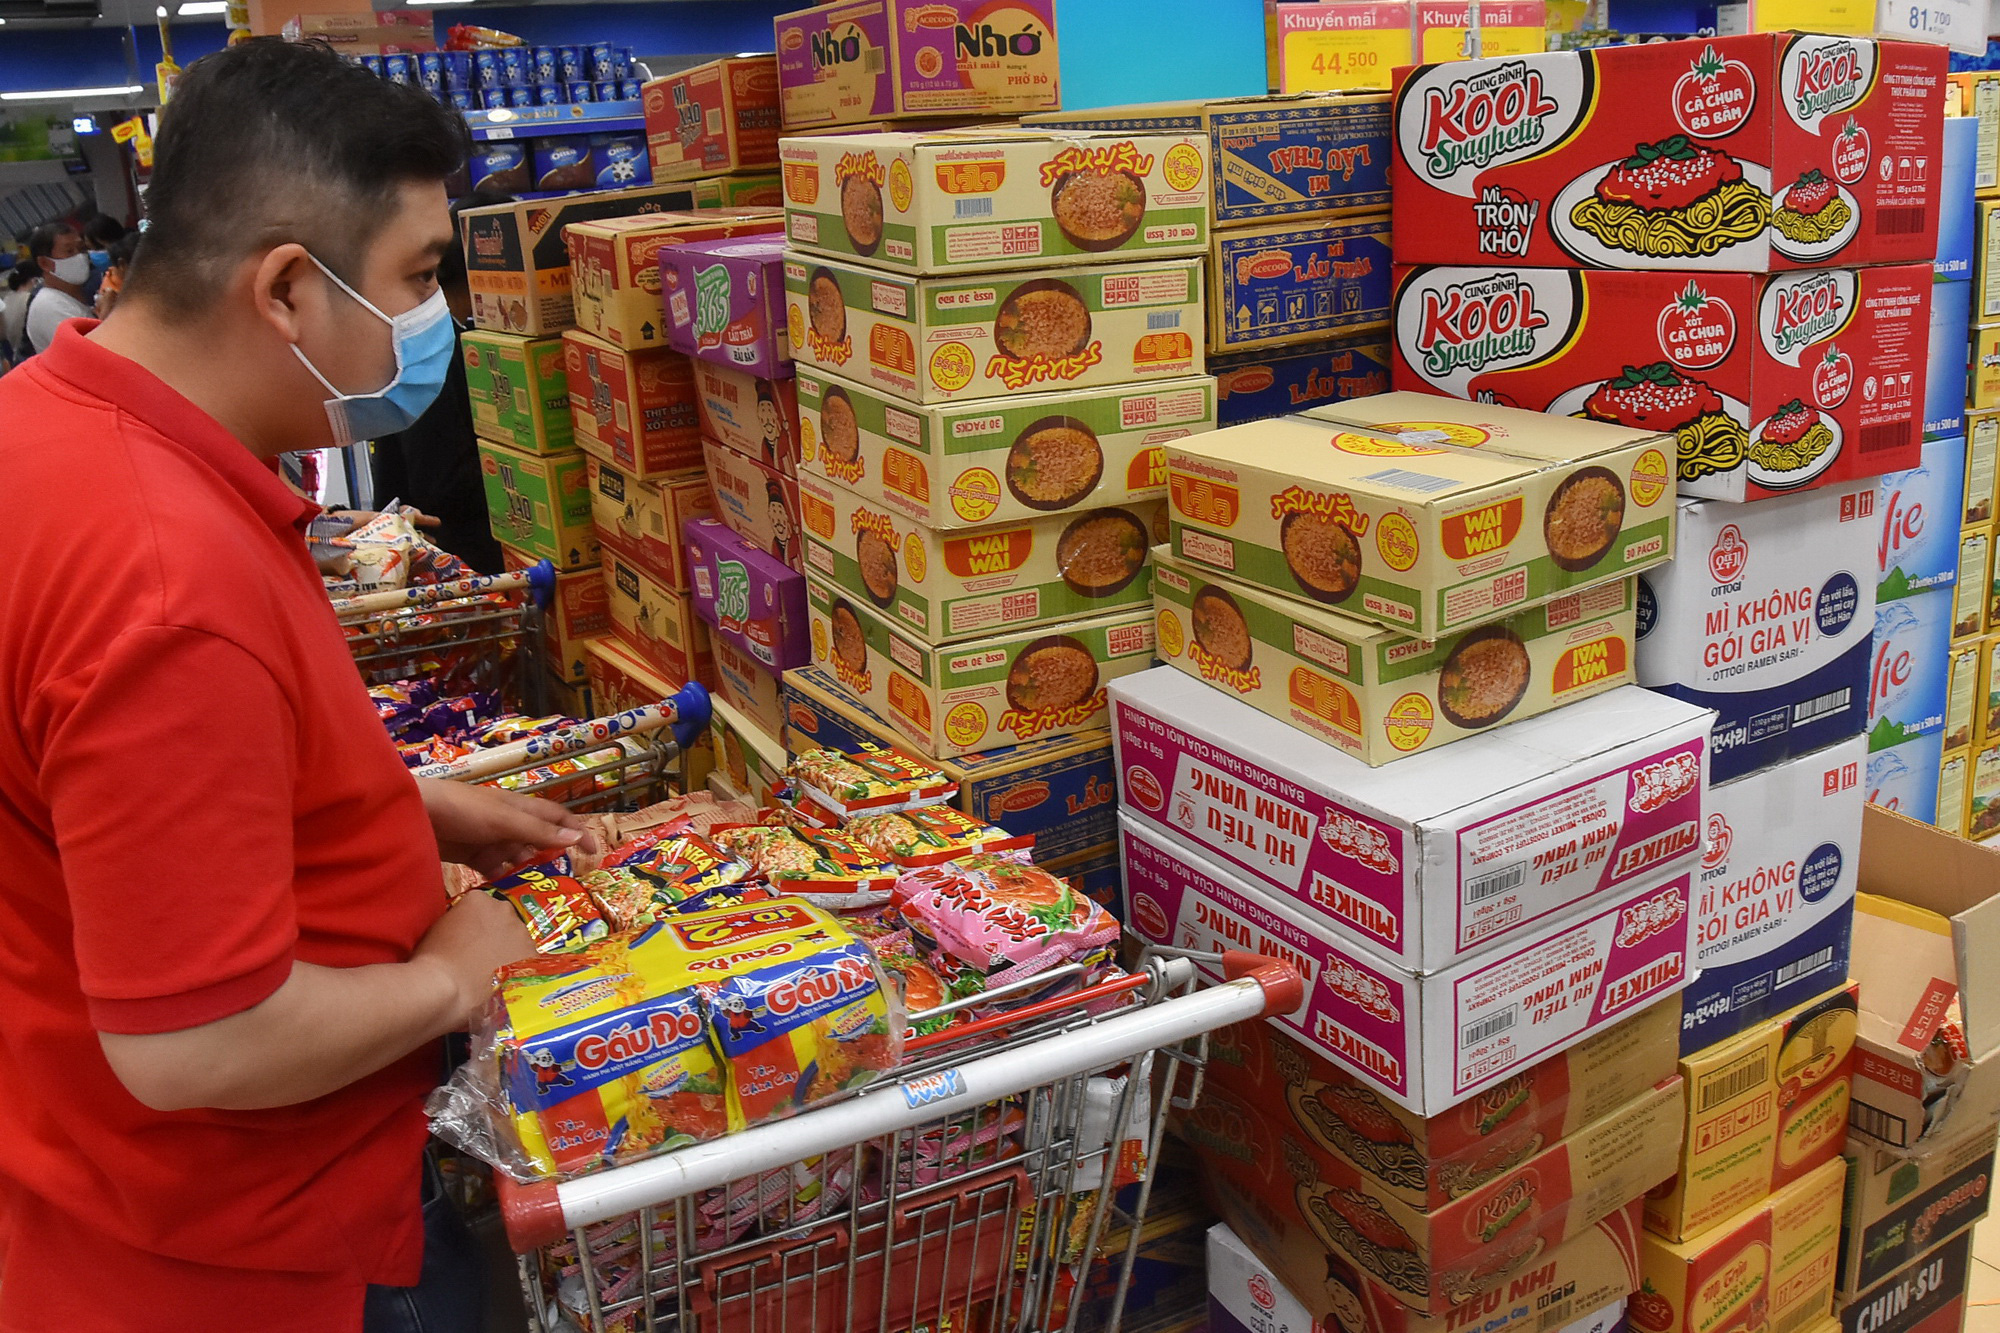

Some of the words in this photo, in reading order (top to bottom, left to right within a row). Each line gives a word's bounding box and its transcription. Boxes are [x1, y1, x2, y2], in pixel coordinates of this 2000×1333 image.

[1284, 13, 1344, 30] Khuyến
[1348, 12, 1377, 28] mãi
[1423, 11, 1484, 29] Khuyế
[1485, 11, 1512, 25] mãi
[811, 24, 861, 70] Nhớ
[955, 23, 1043, 58] Nhớ
[1007, 71, 1030, 85] PHỞ
[1033, 75, 1048, 84] BÒ
[1470, 76, 1497, 95] CUNG
[1498, 65, 1524, 88] ĐÌNH
[1702, 80, 1720, 95] XỐT
[1796, 52, 1862, 98] KOOL
[1425, 76, 1558, 151] KOOL
[1684, 93, 1705, 113] CÀ
[1706, 88, 1744, 110] CHUA
[1798, 79, 1856, 119] Spaghetti
[1691, 110, 1711, 130] BÒ
[1431, 115, 1542, 173] Spaghetti
[1838, 151, 1848, 165] CÀ
[1268, 145, 1323, 174] THÁI
[1327, 144, 1371, 181] LẨU
[1308, 174, 1330, 196] MÌ
[1482, 184, 1502, 204] Mì
[1474, 199, 1529, 231] TRỘN
[1327, 239, 1344, 257] MÌ
[1479, 226, 1524, 254] KHÔ
[1293, 252, 1330, 283] LẨU
[1332, 256, 1373, 279] THÁI
[1464, 283, 1492, 300] CUNG
[1492, 273, 1516, 295] ĐÌNH
[698, 282, 730, 333] 365
[1422, 290, 1549, 349] KOOL
[1685, 314, 1703, 329] XỐT
[1775, 283, 1843, 334] KOOL
[1669, 325, 1688, 343] CÀ
[1690, 322, 1725, 339] CHUA
[1776, 309, 1836, 352] Spaghetti
[1331, 351, 1353, 373] MÌ
[1428, 328, 1533, 372] Spaghetti
[1674, 342, 1693, 360] BÒ
[1288, 367, 1335, 405] LẨU
[955, 421, 986, 434] PACKS
[989, 418, 1001, 429] 30
[1463, 505, 1502, 535] WAI
[969, 534, 1009, 555] WAI
[1463, 527, 1502, 556] WAI
[1626, 549, 1635, 560] 30
[1636, 540, 1661, 557] PACKS
[968, 554, 1010, 575] WAI
[718, 575, 750, 623] 365
[1710, 581, 1742, 598] OTTOGI
[1704, 602, 1730, 637] MÌ
[1736, 586, 1812, 629] KHÔNG
[1837, 609, 1851, 623] Hàn
[1572, 640, 1608, 664] WAI
[1703, 634, 1743, 668] GÓI
[1750, 624, 1787, 654] GIA
[1792, 617, 1811, 645] VỊ
[1572, 658, 1608, 685] WAI
[1712, 663, 1746, 683] OTTOGI
[1747, 653, 1777, 673] RAMEN
[1779, 647, 1799, 663] SARI
[1123, 709, 1147, 731] ĐÌNH
[1148, 719, 1165, 737] GIA
[1166, 726, 1185, 748] MỌI
[1186, 737, 1210, 763] CỦA
[1211, 749, 1243, 778] HÀNH
[1190, 767, 1248, 814] VANG
[1244, 765, 1278, 795] ĐỒNG
[1280, 780, 1306, 804] BẠN
[1207, 805, 1257, 851] TIẾU
[1256, 794, 1309, 839] NAM
[1581, 820, 1618, 847] NAM
[1265, 832, 1296, 867] HỦ
[1532, 838, 1577, 871] VANG
[1615, 822, 1697, 879] MILIKET
[1820, 878, 1835, 892] Hàn
[1826, 866, 1839, 880] cay
[1314, 878, 1398, 942] MILIKET
[1731, 929, 1761, 951] RAMEN
[1762, 921, 1783, 937] SARI
[1568, 958, 1604, 982] NAM
[1603, 954, 1682, 1012] MILIKET
[766, 968, 839, 1016] Gấu
[1522, 976, 1564, 1012] VANG
[575, 1022, 651, 1070] Gấu
[650, 1003, 702, 1050] Đỏ
[1317, 1018, 1402, 1086] MILIKET
[1856, 1257, 1945, 1333] CHIN-SU
